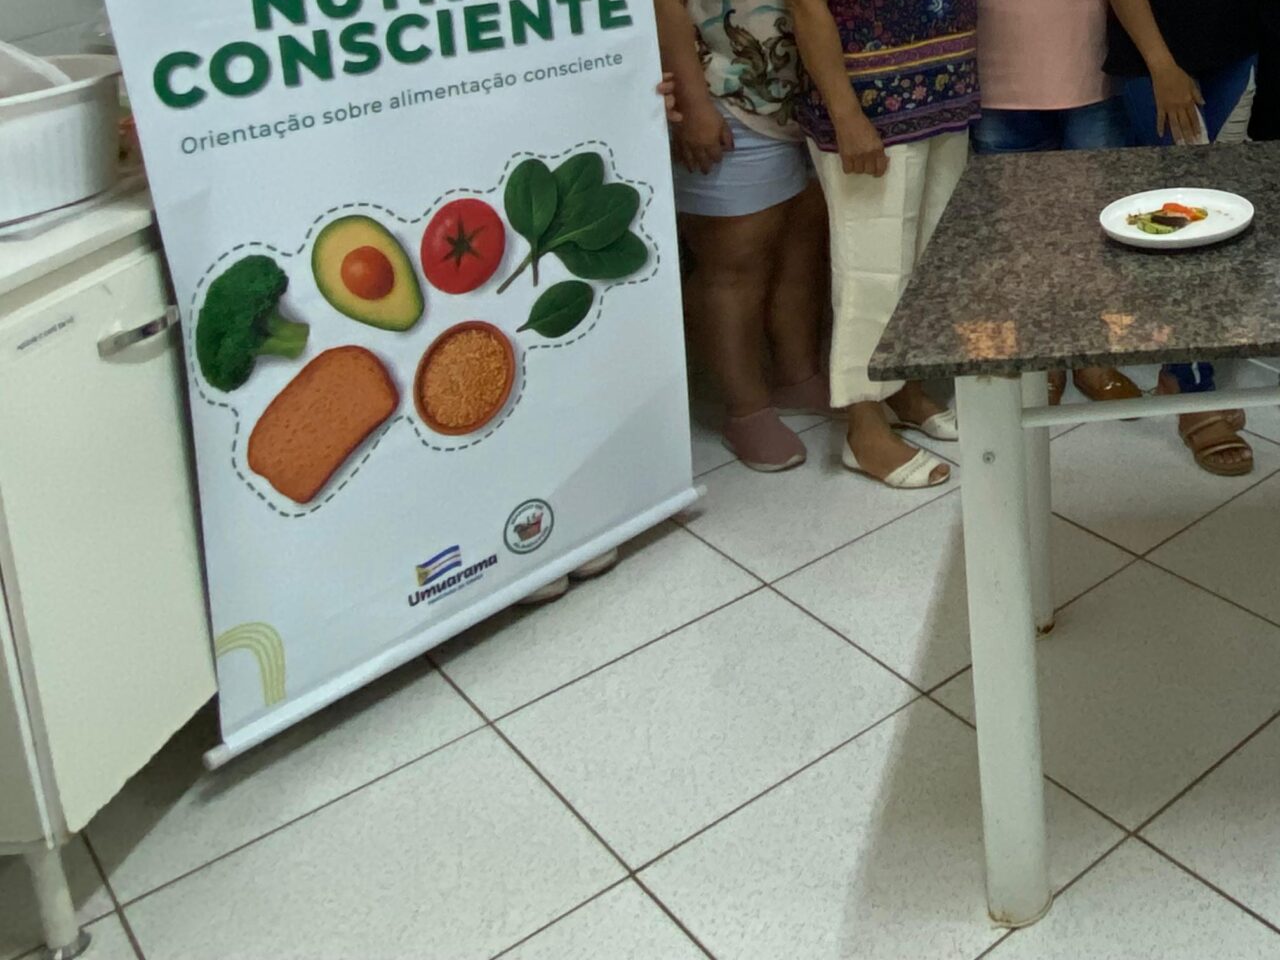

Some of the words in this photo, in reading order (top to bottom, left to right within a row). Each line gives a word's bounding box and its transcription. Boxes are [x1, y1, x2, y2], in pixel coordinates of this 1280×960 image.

[180, 110, 314, 154] Orientação
[322, 96, 382, 126] sobre
[389, 70, 517, 109] alimentação
[523, 51, 623, 83] consciente
[408, 553, 497, 606] Umuarama
